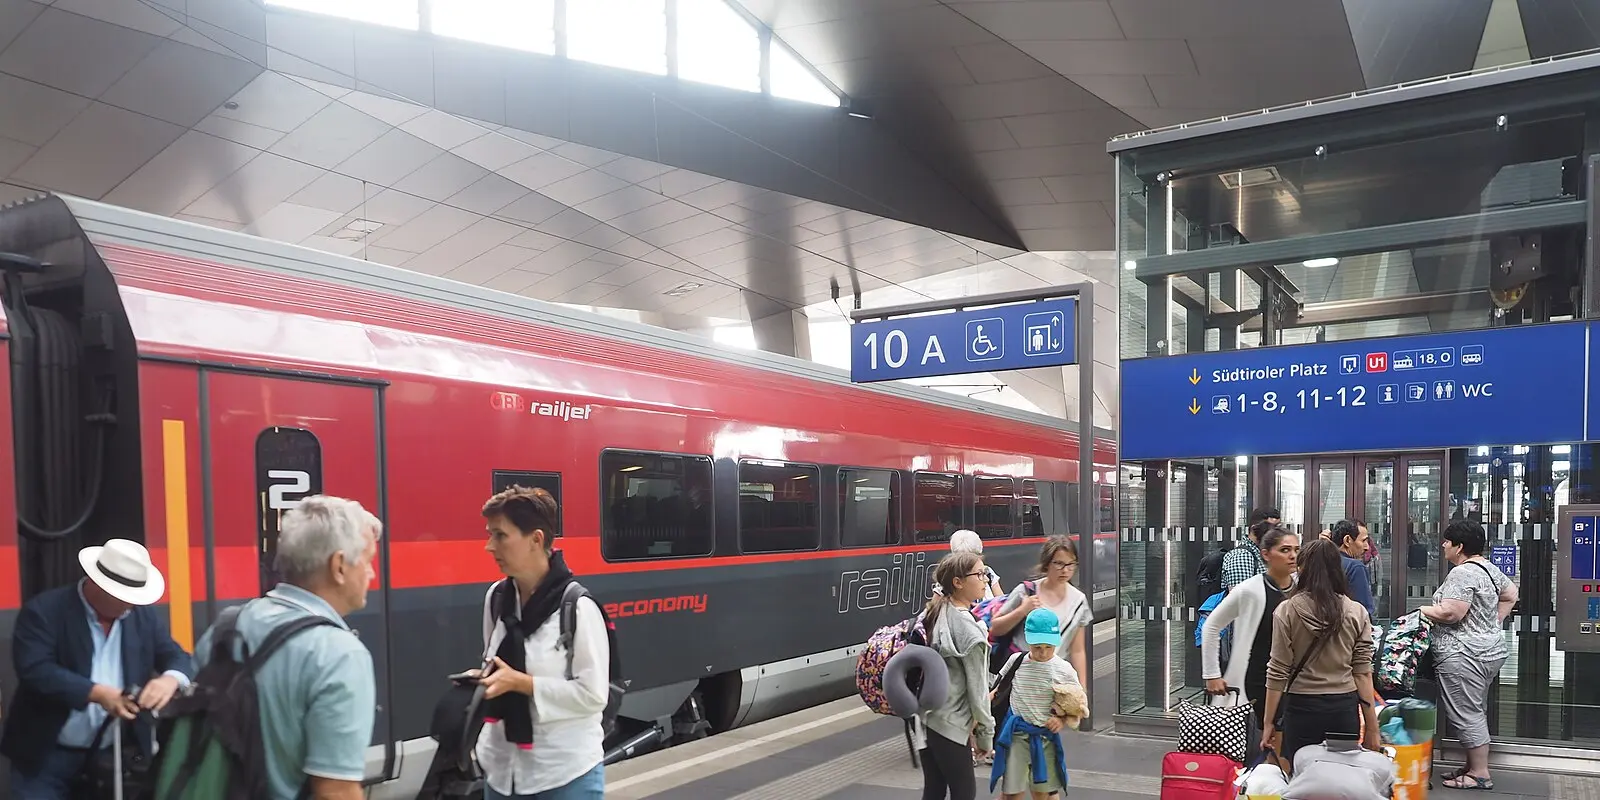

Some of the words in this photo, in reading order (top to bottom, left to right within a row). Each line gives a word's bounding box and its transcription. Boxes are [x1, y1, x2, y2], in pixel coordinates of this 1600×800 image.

[863, 329, 909, 370] 10
[920, 335, 947, 366] A
[1212, 365, 1285, 384] Südtiroler
[1289, 362, 1328, 378] Platz
[1368, 357, 1385, 369] U1
[1419, 353, 1438, 365] 18,
[530, 400, 592, 422] railjet
[1236, 391, 1287, 414] 1-8,
[1296, 385, 1367, 410] 11-12
[1461, 382, 1494, 398] WC
[267, 469, 311, 510] 2
[603, 593, 709, 620] economy
